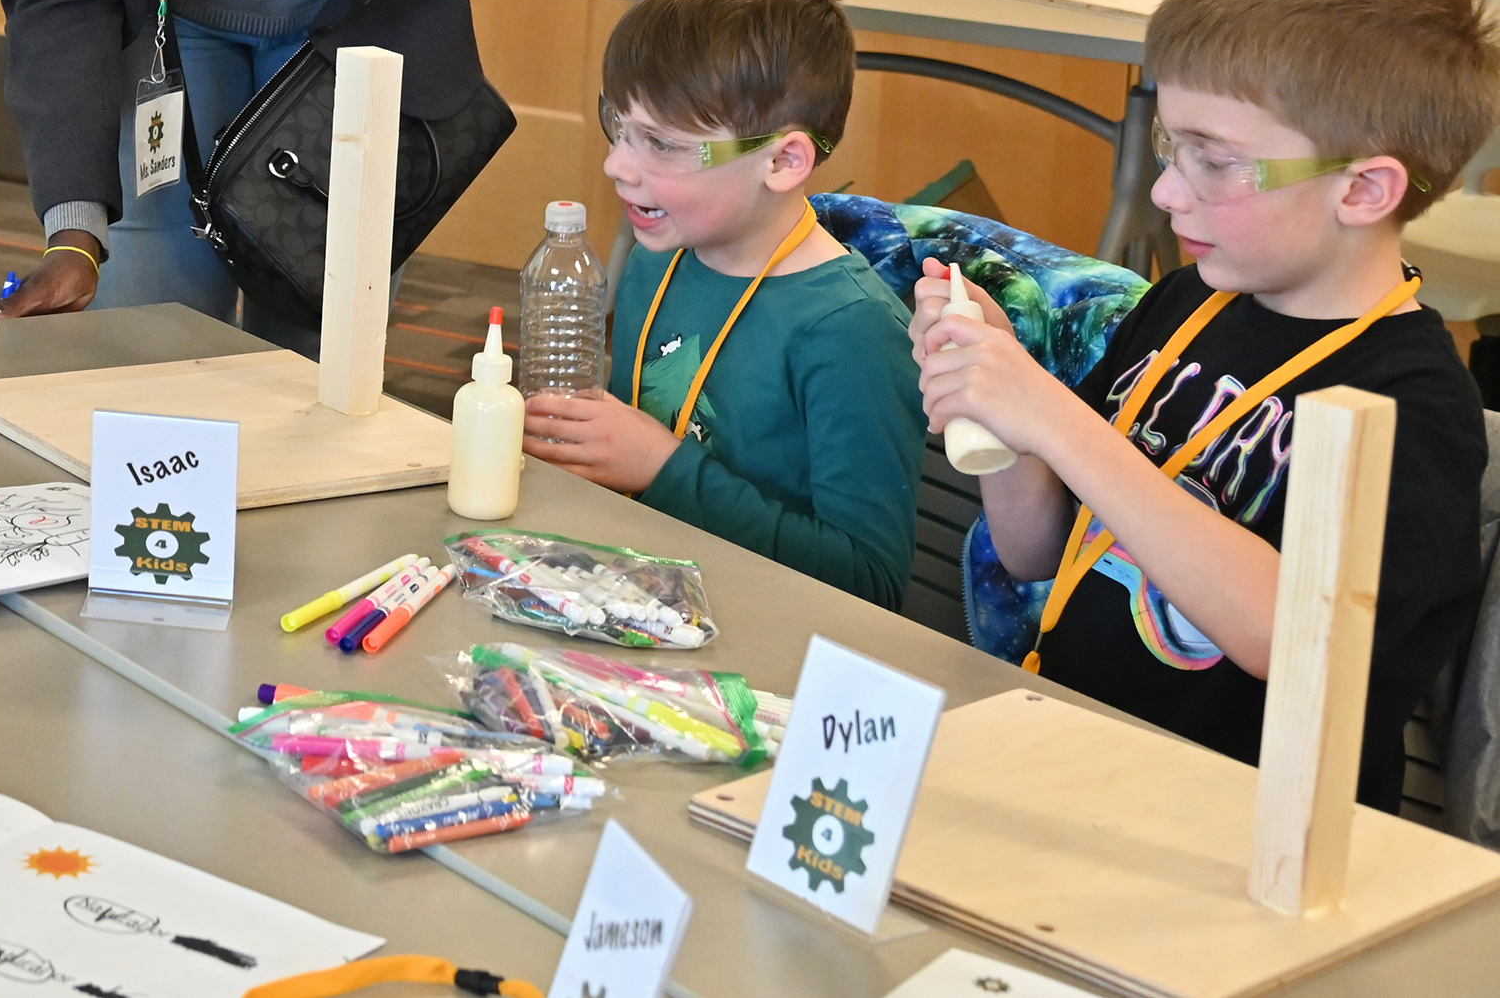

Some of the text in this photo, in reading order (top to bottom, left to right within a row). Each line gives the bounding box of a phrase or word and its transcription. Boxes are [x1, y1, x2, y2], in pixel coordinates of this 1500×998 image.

[150, 155, 176, 176] Sanders
[126, 450, 199, 486] Isaac
[135, 517, 192, 532] STEM
[154, 539, 168, 550] 4
[136, 557, 188, 572] Kids
[822, 709, 897, 754] Dylan
[810, 791, 863, 827] STEM
[797, 844, 844, 880] Kids
[583, 910, 663, 952] Jameson
